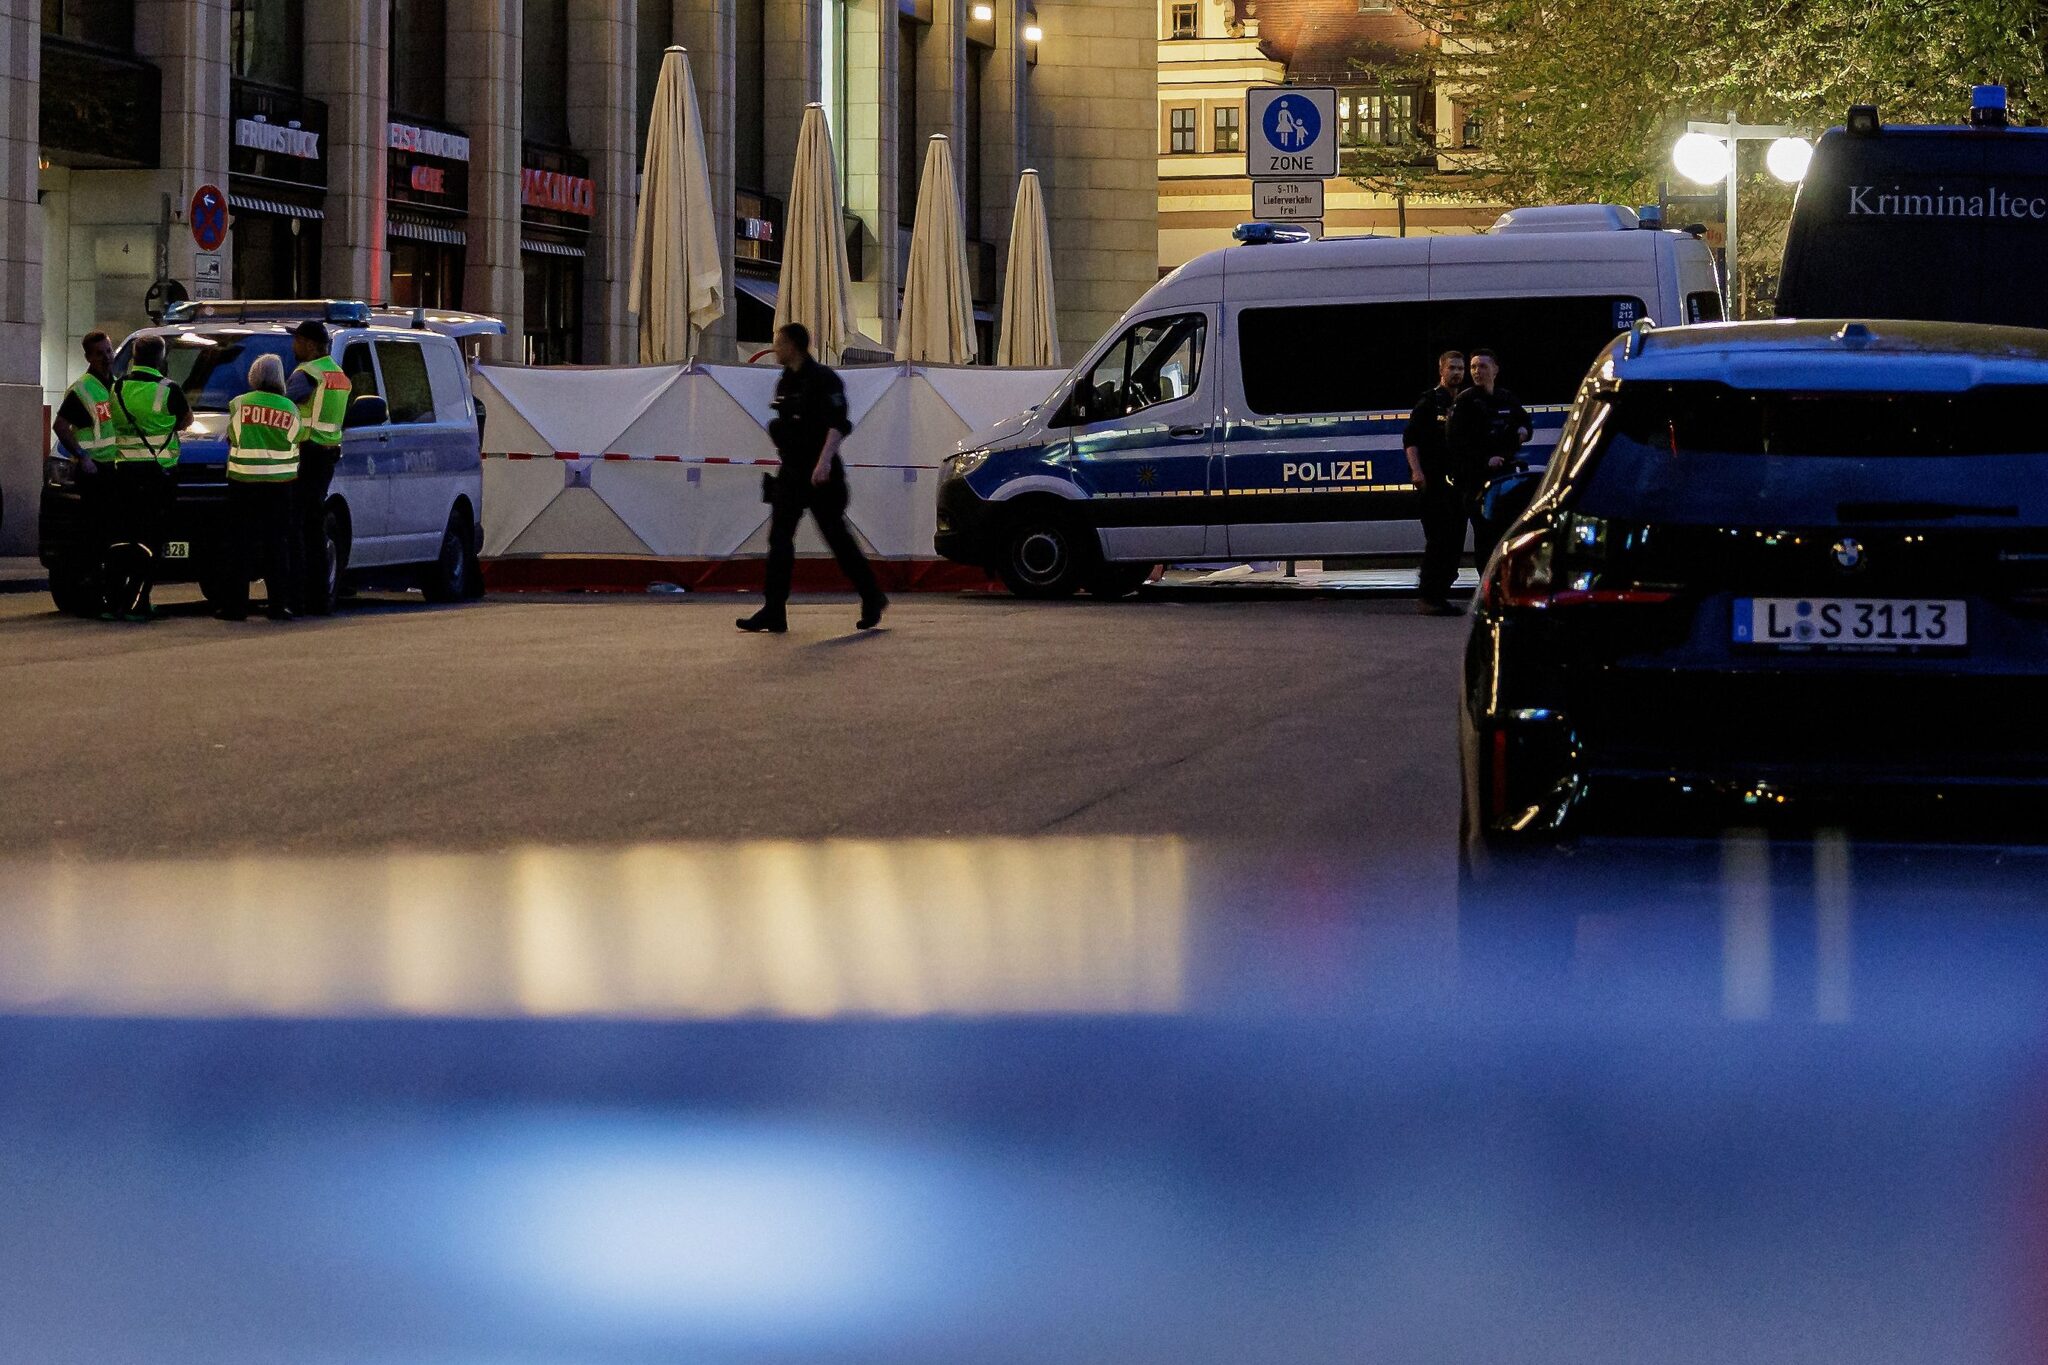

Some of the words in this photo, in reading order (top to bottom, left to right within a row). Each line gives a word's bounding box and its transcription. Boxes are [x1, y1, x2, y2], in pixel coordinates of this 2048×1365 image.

[1270, 156, 1314, 170] ZONE
[1263, 195, 1313, 205] Lieferverkehr
[1848, 185, 2047, 219] Kriminaltec
[1280, 206, 1297, 215] frei
[122, 244, 130, 255] 4
[1620, 302, 1633, 310] SN
[1618, 311, 1634, 319] 212
[1283, 461, 1373, 481] POLIZEI
[1768, 603, 1792, 639] L
[1819, 603, 1842, 638] S
[1852, 603, 1947, 639] 3113
